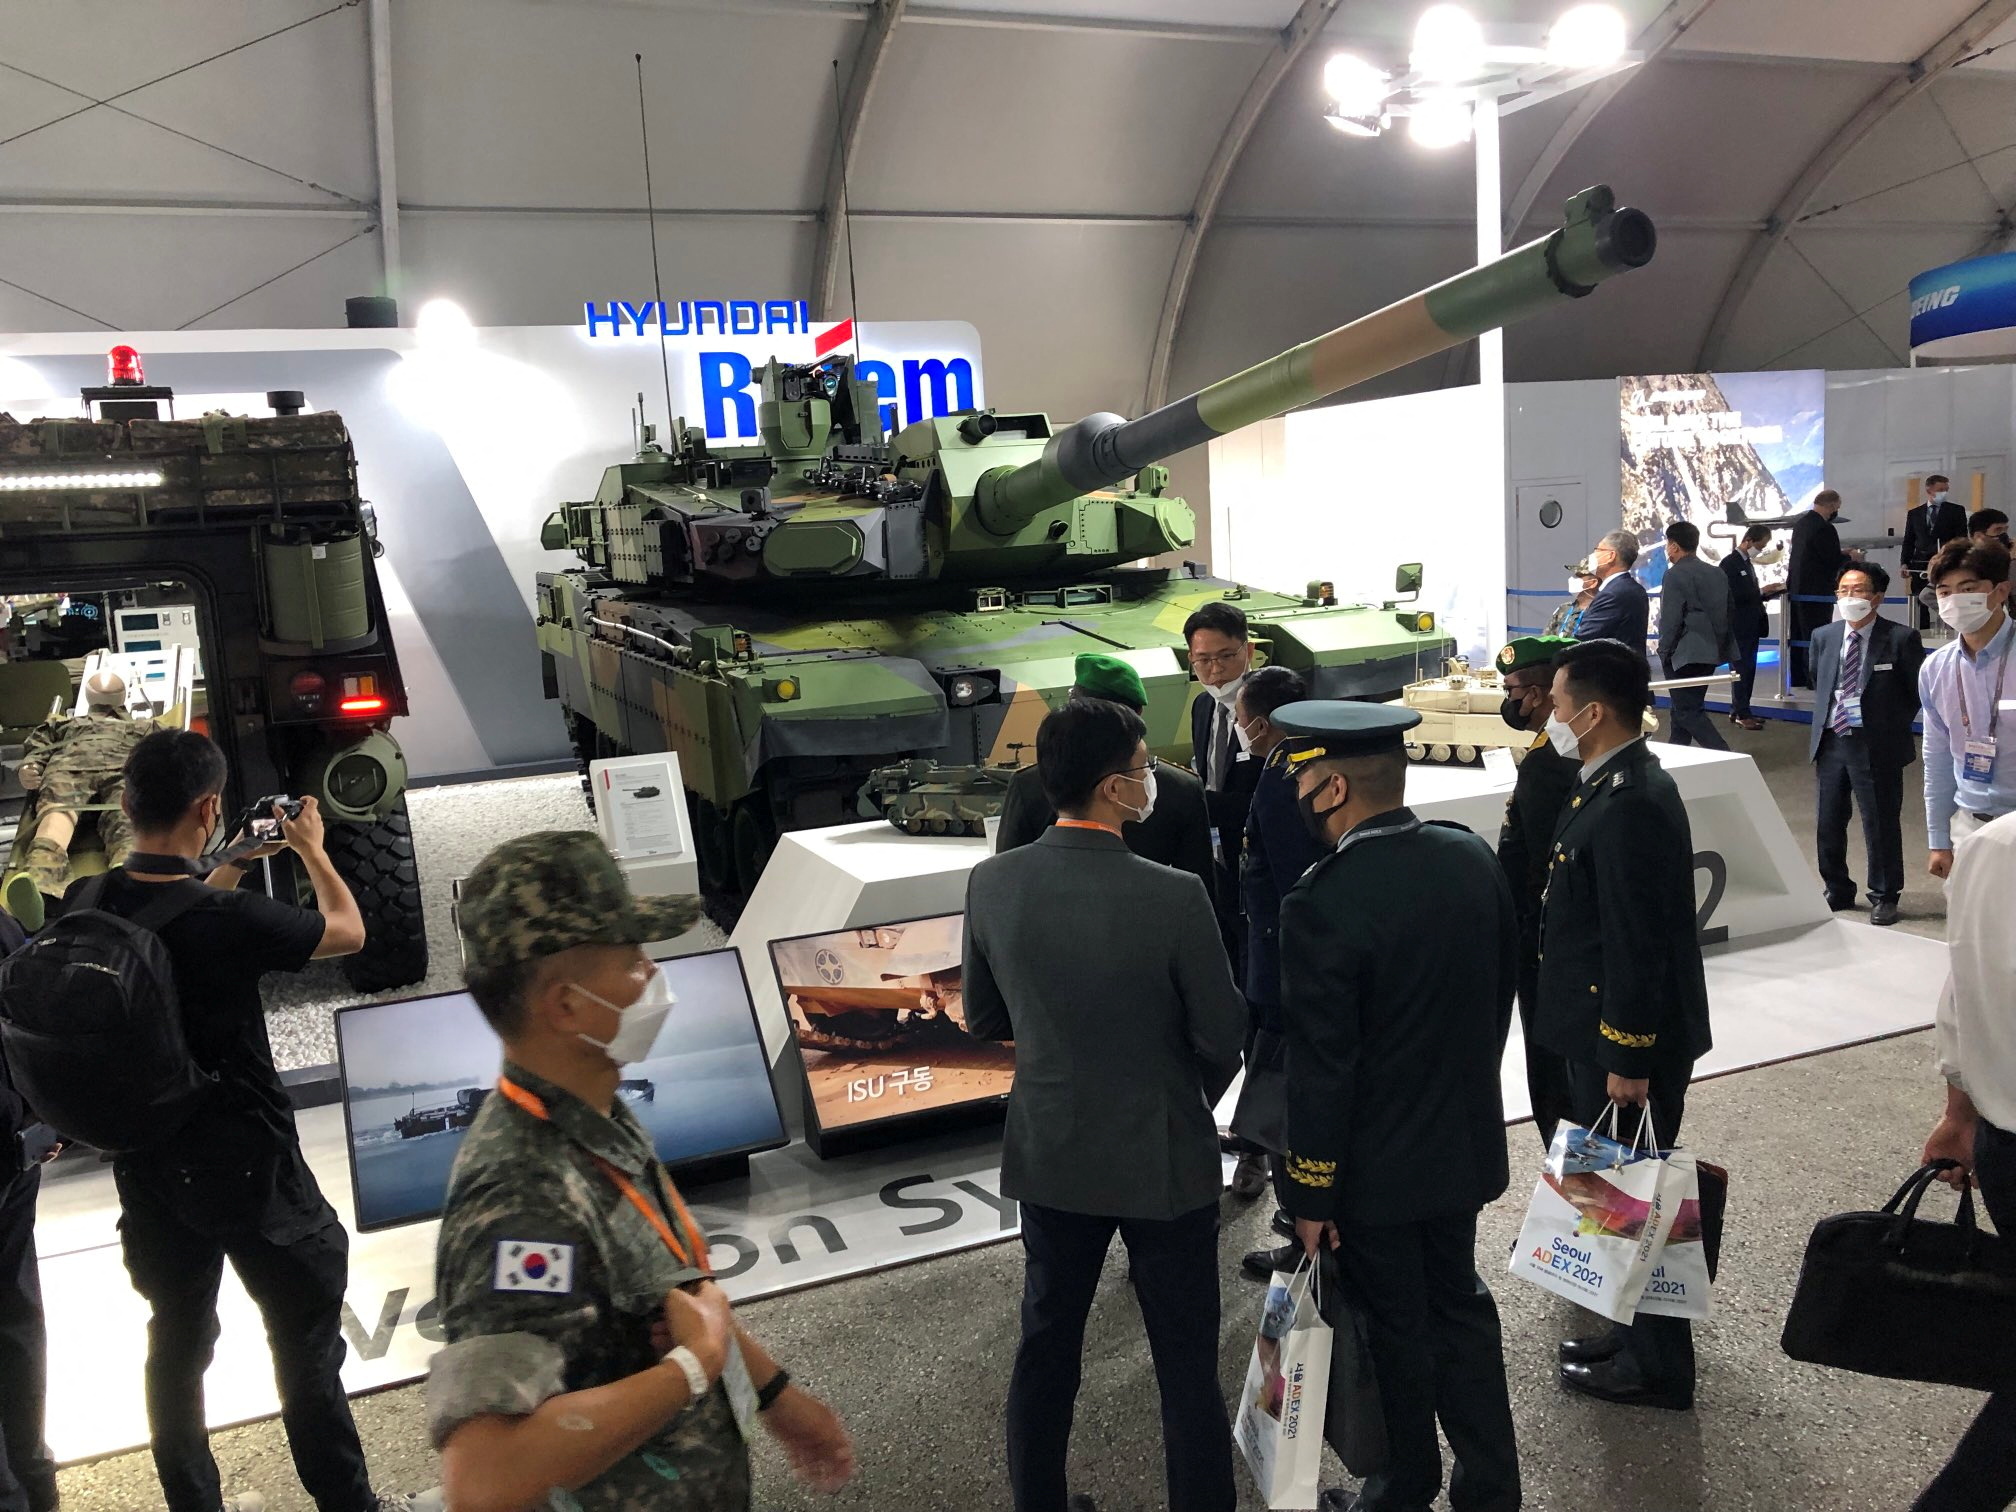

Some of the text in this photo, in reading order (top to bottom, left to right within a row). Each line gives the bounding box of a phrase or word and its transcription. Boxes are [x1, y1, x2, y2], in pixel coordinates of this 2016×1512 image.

[584, 300, 809, 337] HYUNDAI
[848, 1065, 934, 1103] ISU 구동
[1551, 1237, 1591, 1264] Seoul
[1532, 1246, 1571, 1273] ADEX
[1572, 1264, 1604, 1289] 2021
[1652, 1280, 1686, 1296] 2021
[1289, 1384, 1302, 1414] ADEX
[1287, 1414, 1299, 1440] 2021
